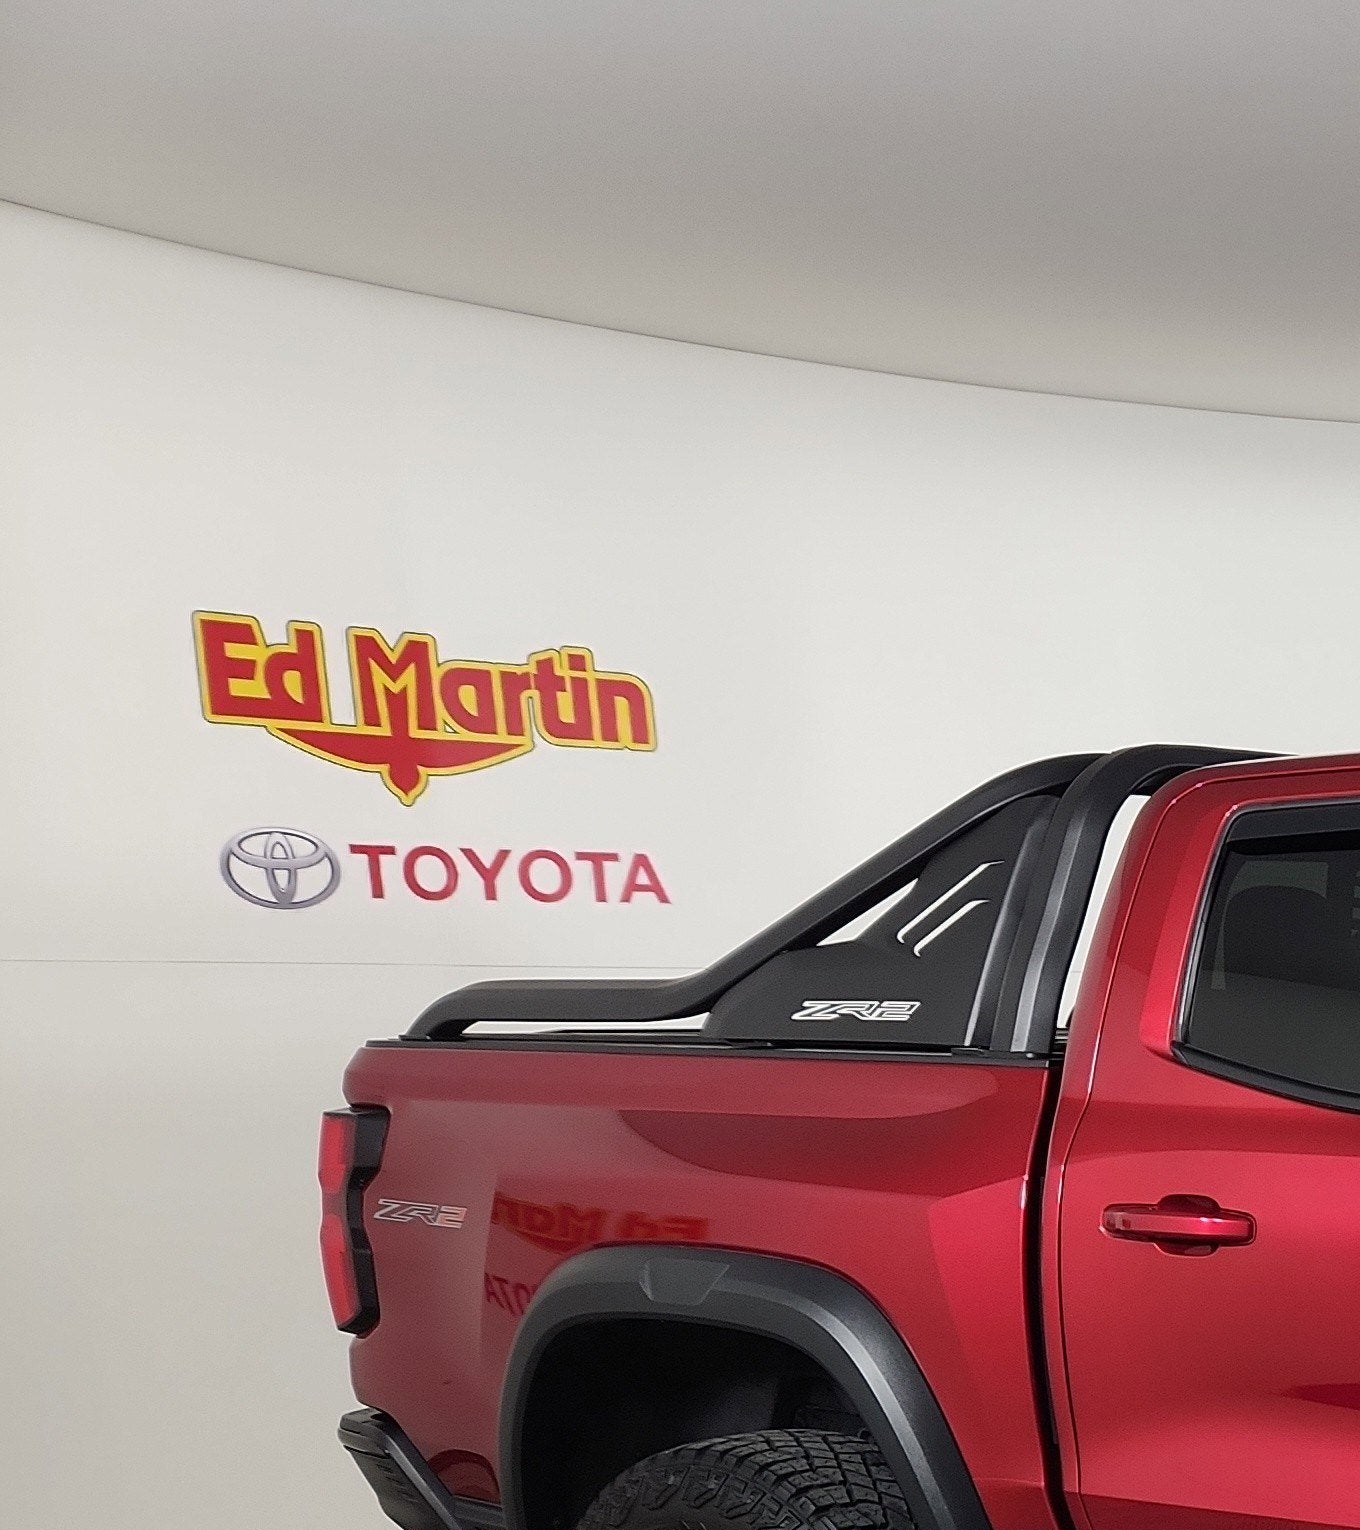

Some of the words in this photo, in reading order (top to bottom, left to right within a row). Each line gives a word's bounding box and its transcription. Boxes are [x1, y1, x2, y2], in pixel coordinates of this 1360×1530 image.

[197, 615, 326, 724] Ed
[353, 632, 651, 746] Martin
[349, 843, 672, 904] TOYOTA
[790, 999, 921, 1022] ZR2
[373, 1199, 467, 1229] ZR2
